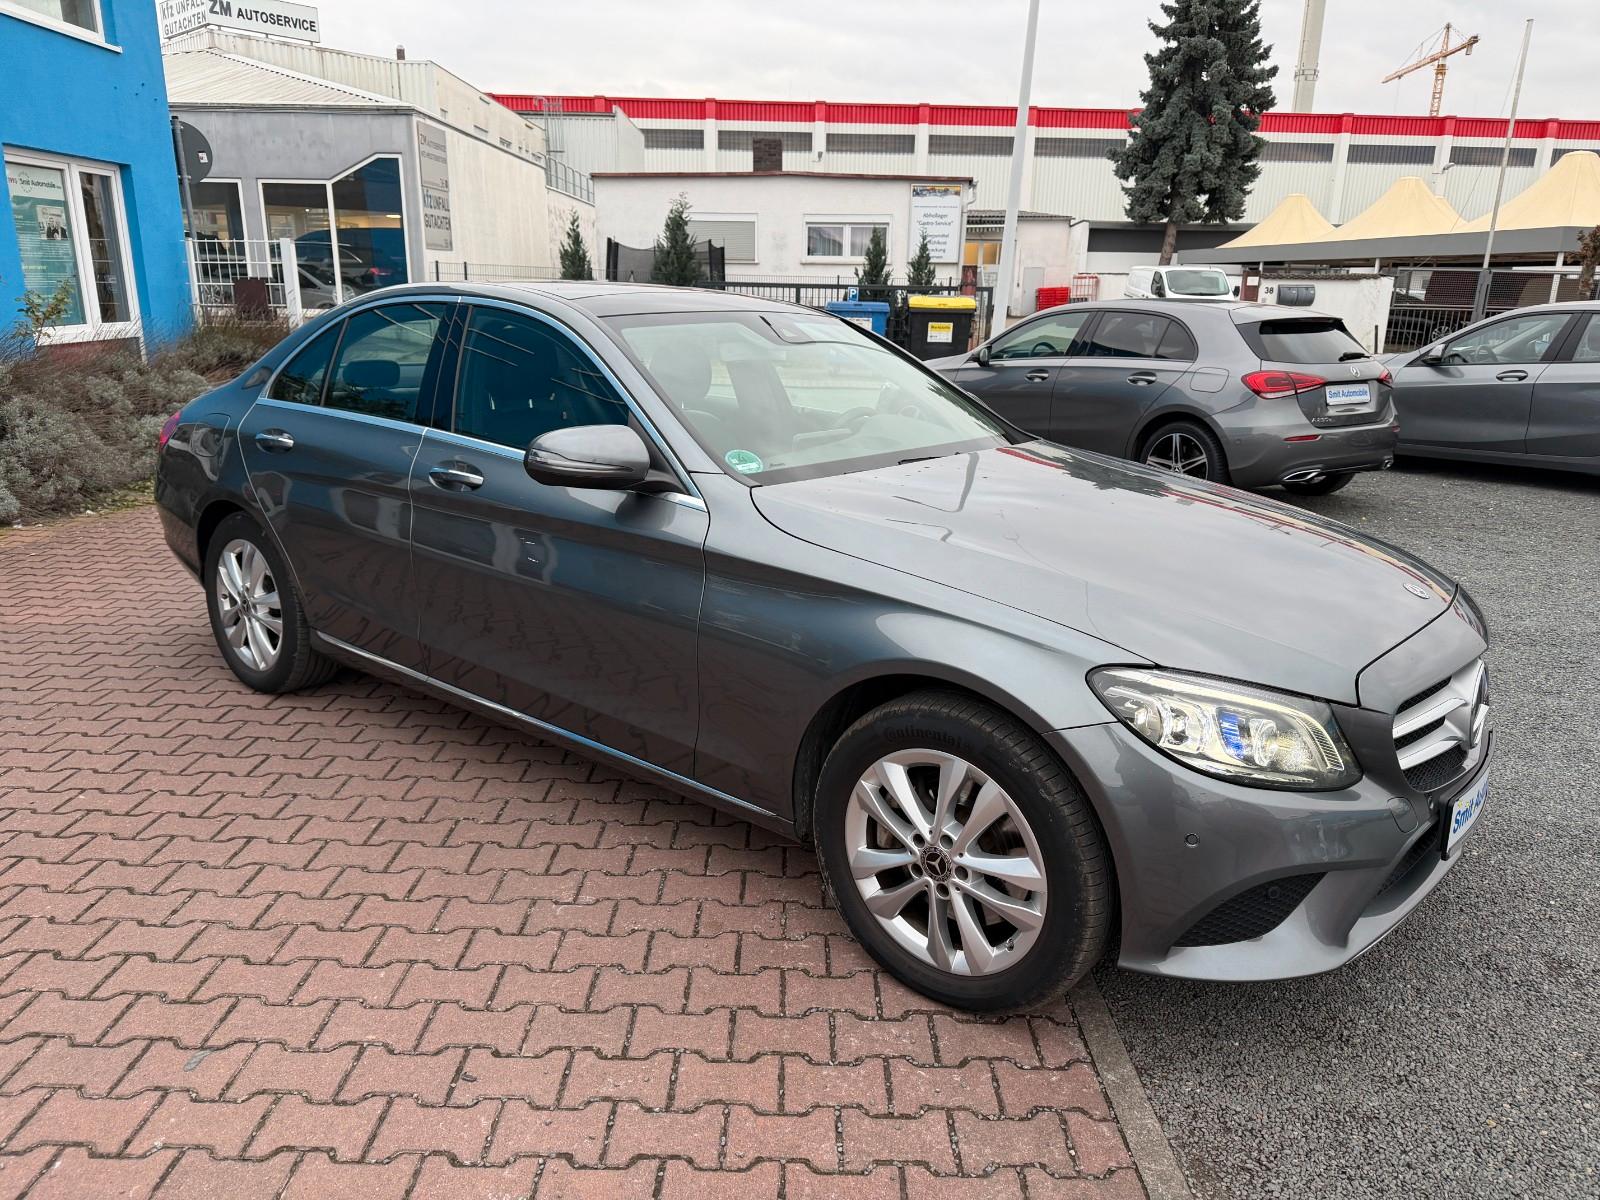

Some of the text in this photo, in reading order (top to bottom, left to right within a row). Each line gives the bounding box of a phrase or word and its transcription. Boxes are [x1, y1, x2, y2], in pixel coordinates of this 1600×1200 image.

[175, 0, 205, 14] UNFALL
[164, 9, 207, 36] GUTACHTEN
[208, 0, 317, 33] ZM AUTOSERVICE
[424, 213, 451, 232] GUTACHTEN
[850, 289, 857, 298] P
[1264, 286, 1274, 295] 38
[1328, 387, 1368, 399] Smit Automobile
[1453, 799, 1474, 834] Smit
